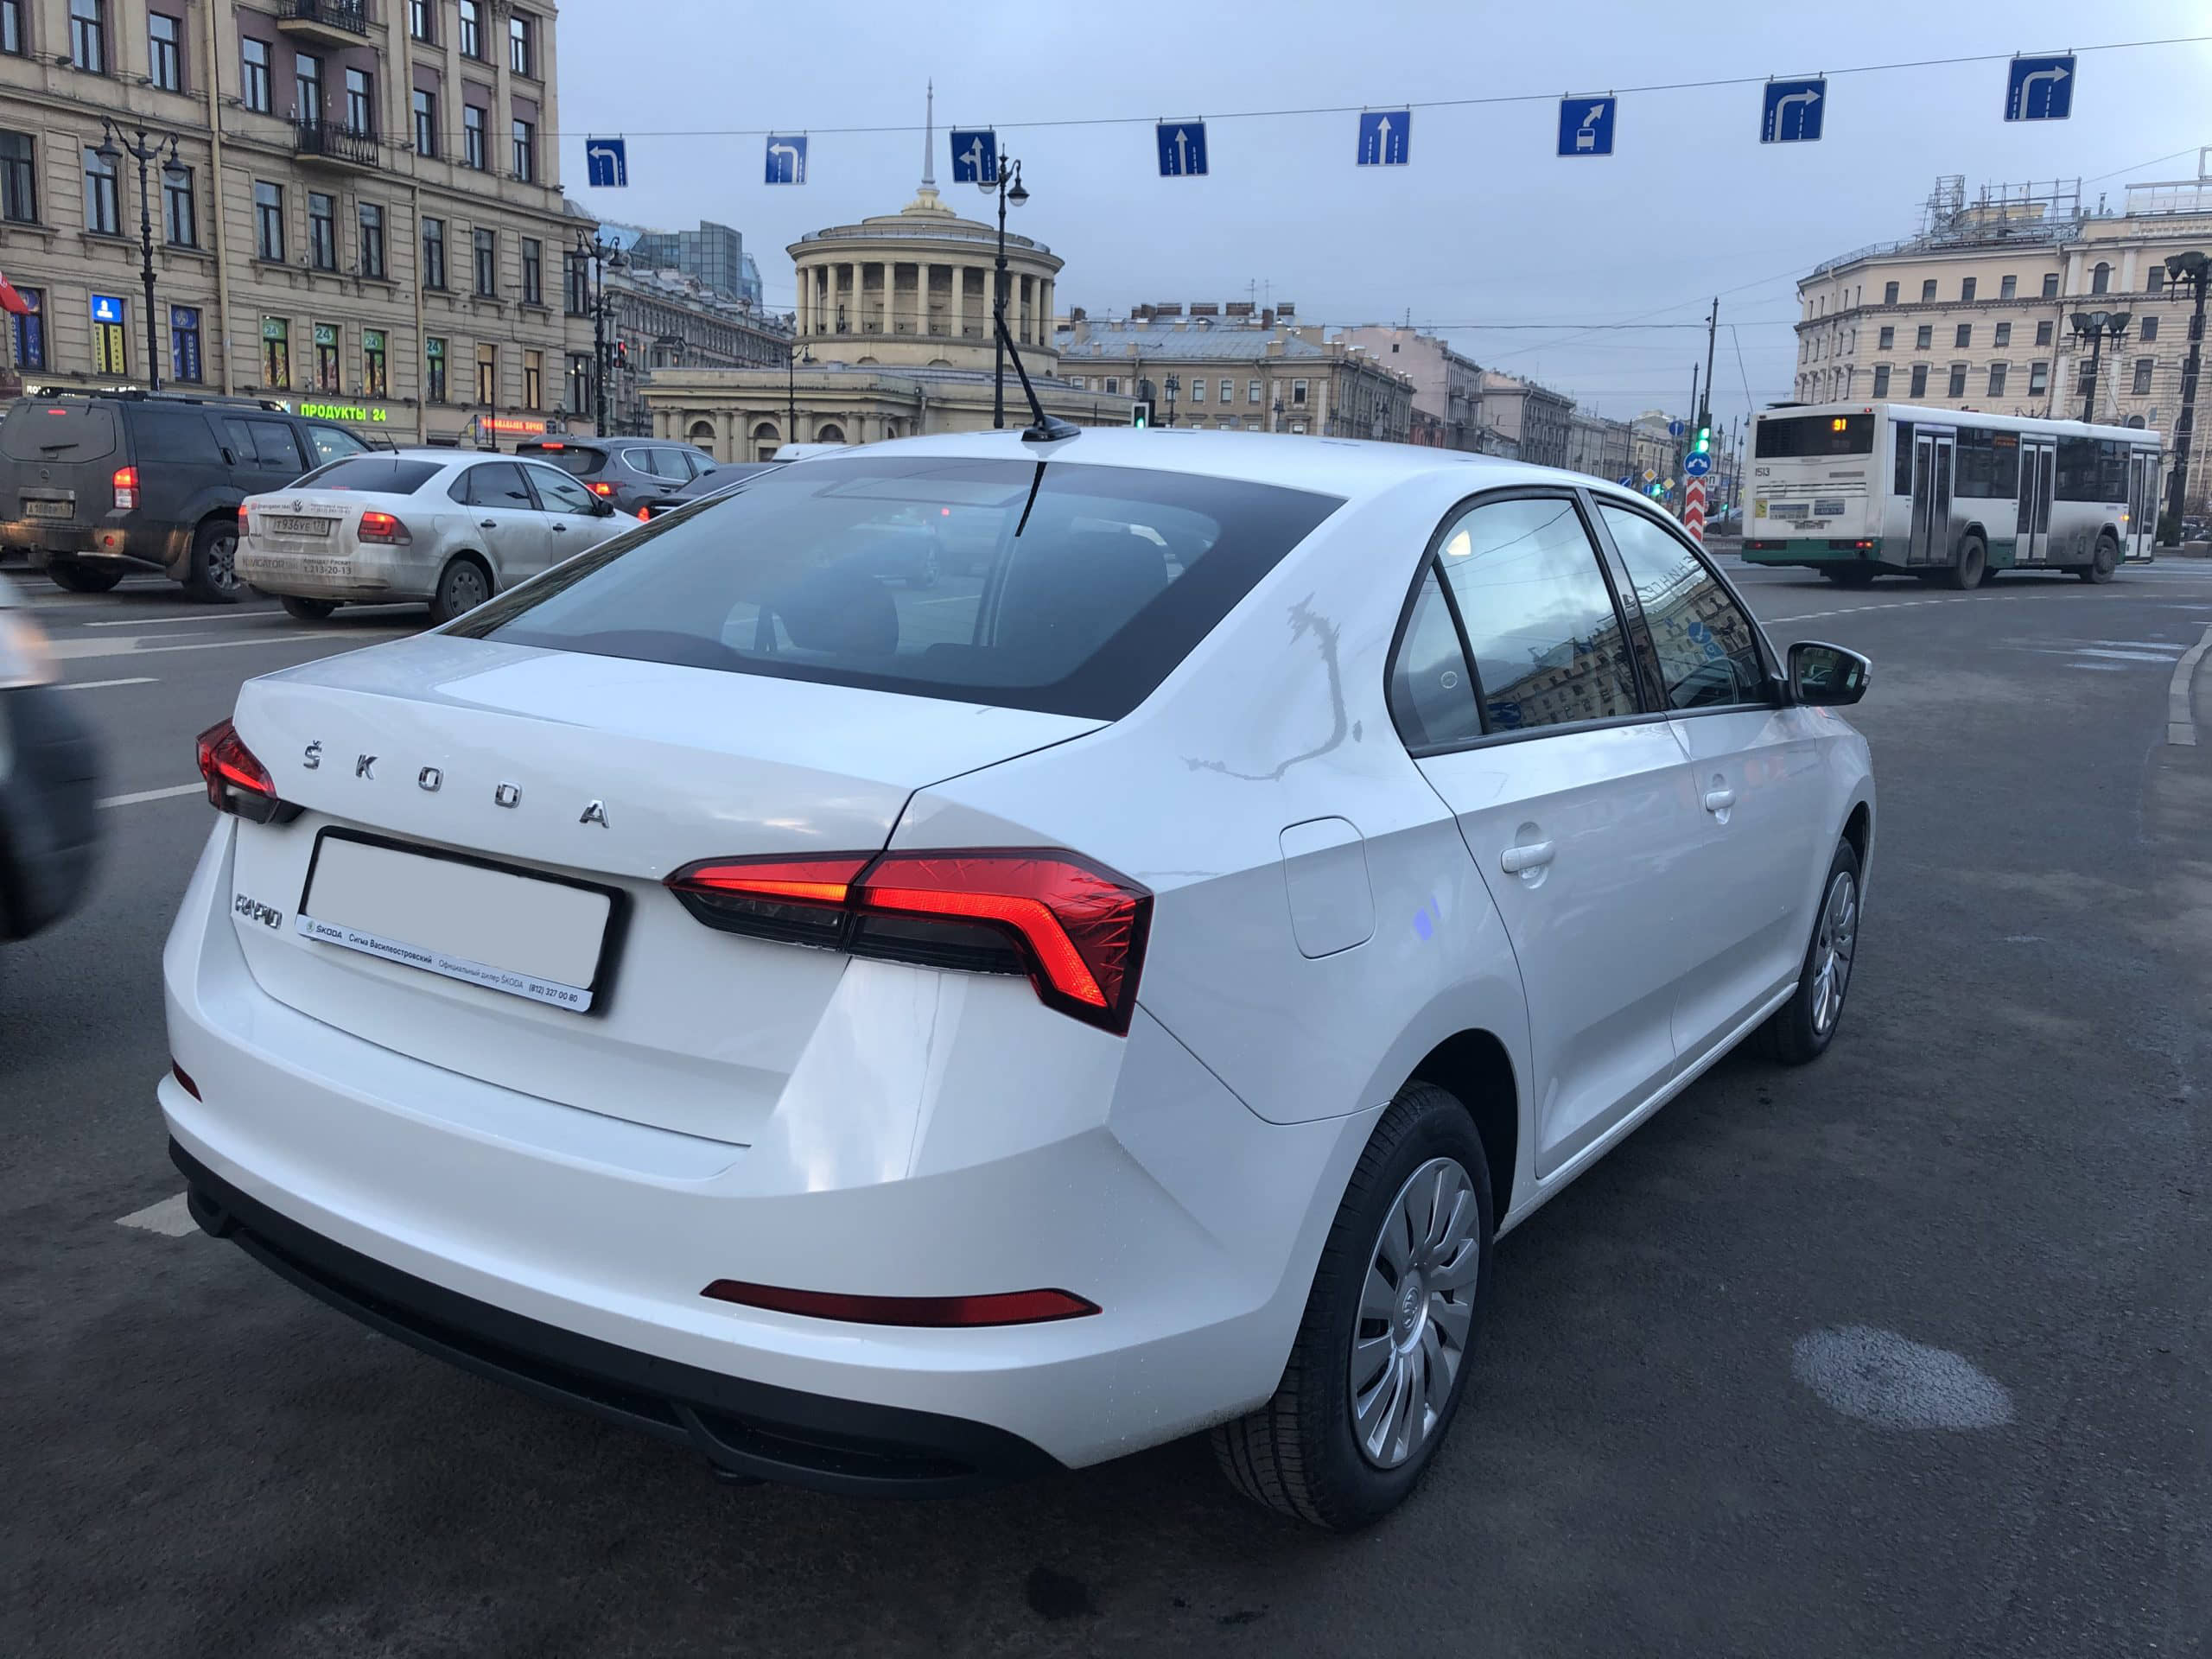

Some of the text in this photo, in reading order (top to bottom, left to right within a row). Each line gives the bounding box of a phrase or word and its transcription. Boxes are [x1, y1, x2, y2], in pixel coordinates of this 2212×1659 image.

[266, 325, 277, 335] 24
[315, 327, 331, 340] 24
[366, 338, 378, 347] 24
[427, 341, 440, 352] 24
[301, 404, 386, 422] ПРОДУКТЫ 24
[1833, 418, 1847, 430] 91
[1756, 467, 1770, 476] 1513
[303, 740, 611, 829] ŠKODA
[235, 893, 283, 930] RAPID
[316, 925, 342, 939] ŠKODA
[349, 933, 369, 946] Сигма
[370, 939, 432, 964] Василеостровский
[438, 959, 481, 977] Официальный
[481, 971, 500, 982] дилер
[528, 983, 545, 995] (812)
[546, 988, 557, 996] 327
[558, 991, 569, 1000] 00
[569, 993, 578, 1002] 80
